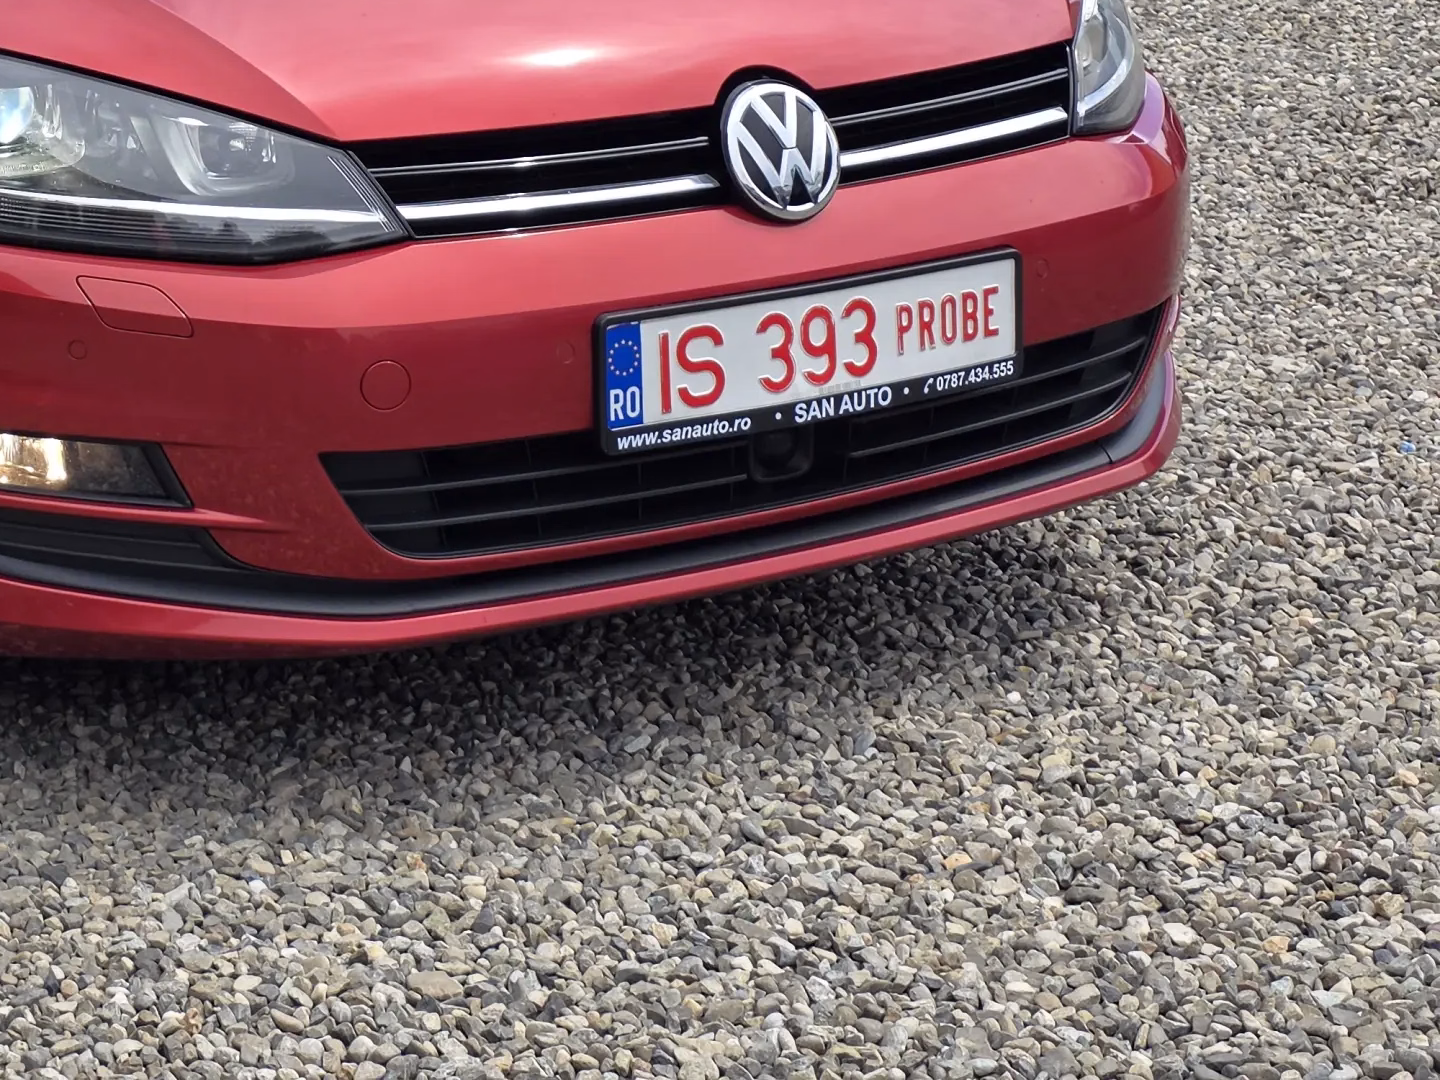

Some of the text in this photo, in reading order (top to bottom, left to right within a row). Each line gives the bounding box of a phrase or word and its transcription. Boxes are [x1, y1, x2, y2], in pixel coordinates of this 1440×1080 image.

[658, 284, 999, 415] IS 393 PROBE
[609, 386, 641, 422] RO
[617, 360, 1014, 450] www.sanauto.ro SAN AUTO 0787.434.555
